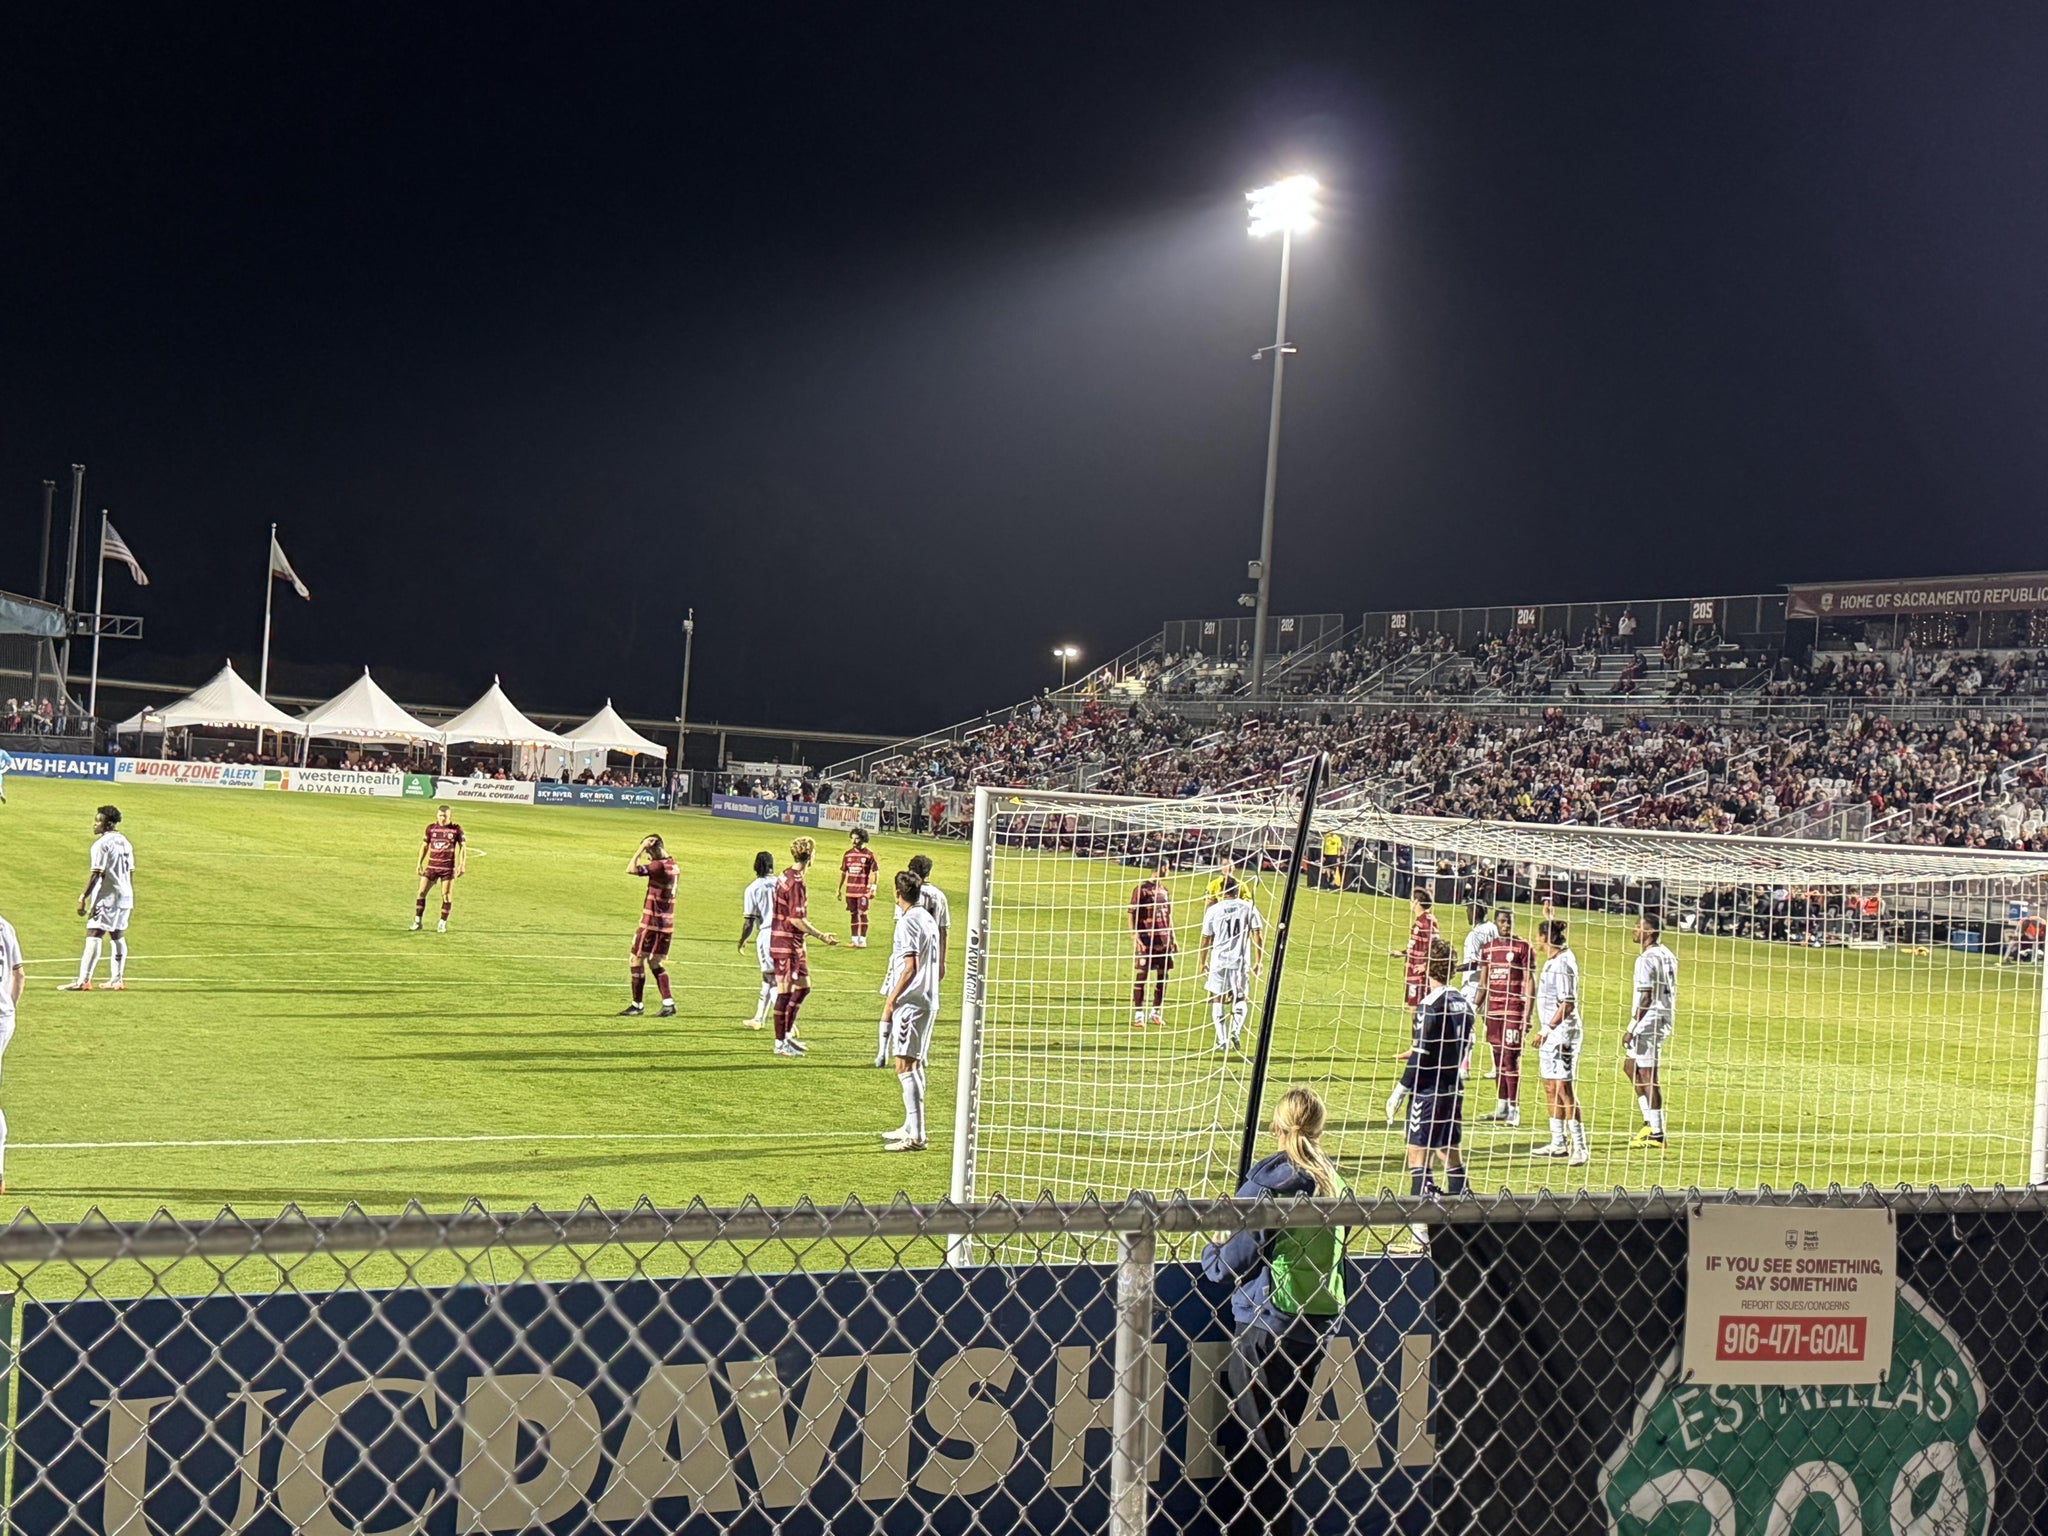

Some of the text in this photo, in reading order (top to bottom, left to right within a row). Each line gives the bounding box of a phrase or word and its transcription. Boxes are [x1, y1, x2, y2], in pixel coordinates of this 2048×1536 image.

[1840, 594, 1873, 609] HOME
[1876, 593, 1891, 607] OF
[1893, 590, 1981, 607] SACRAMENTO
[1517, 608, 1536, 625] 204
[1692, 601, 1713, 619] 205
[1204, 622, 1215, 635] 201
[1281, 618, 1294, 632] 202
[1391, 614, 1406, 629] 203
[44, 758, 109, 776] HEALTH
[117, 761, 258, 781] BE WORK ZONE ALERT
[297, 784, 375, 796] ADVANTAGE
[457, 790, 530, 800] DENTAL COVERAGE
[473, 782, 515, 791] FLOP-FREE
[537, 790, 573, 799] SKY RIVER
[594, 792, 614, 800] RIVER
[621, 793, 635, 801] SKY
[635, 794, 655, 803] RIVER
[826, 806, 843, 821] WORK
[844, 808, 860, 822] ZONE
[861, 811, 877, 823] ALERT
[1225, 918, 1241, 938] 14
[1505, 1028, 1520, 1045] 90
[1705, 1255, 1884, 1276] IF YOU SEE SOMETHING,
[1735, 1275, 1858, 1292] SAY SOMETHING
[1741, 1300, 1850, 1311] REPORT ISSUES/CONCERNS
[1723, 1322, 1859, 1355] 916-471-GOAL
